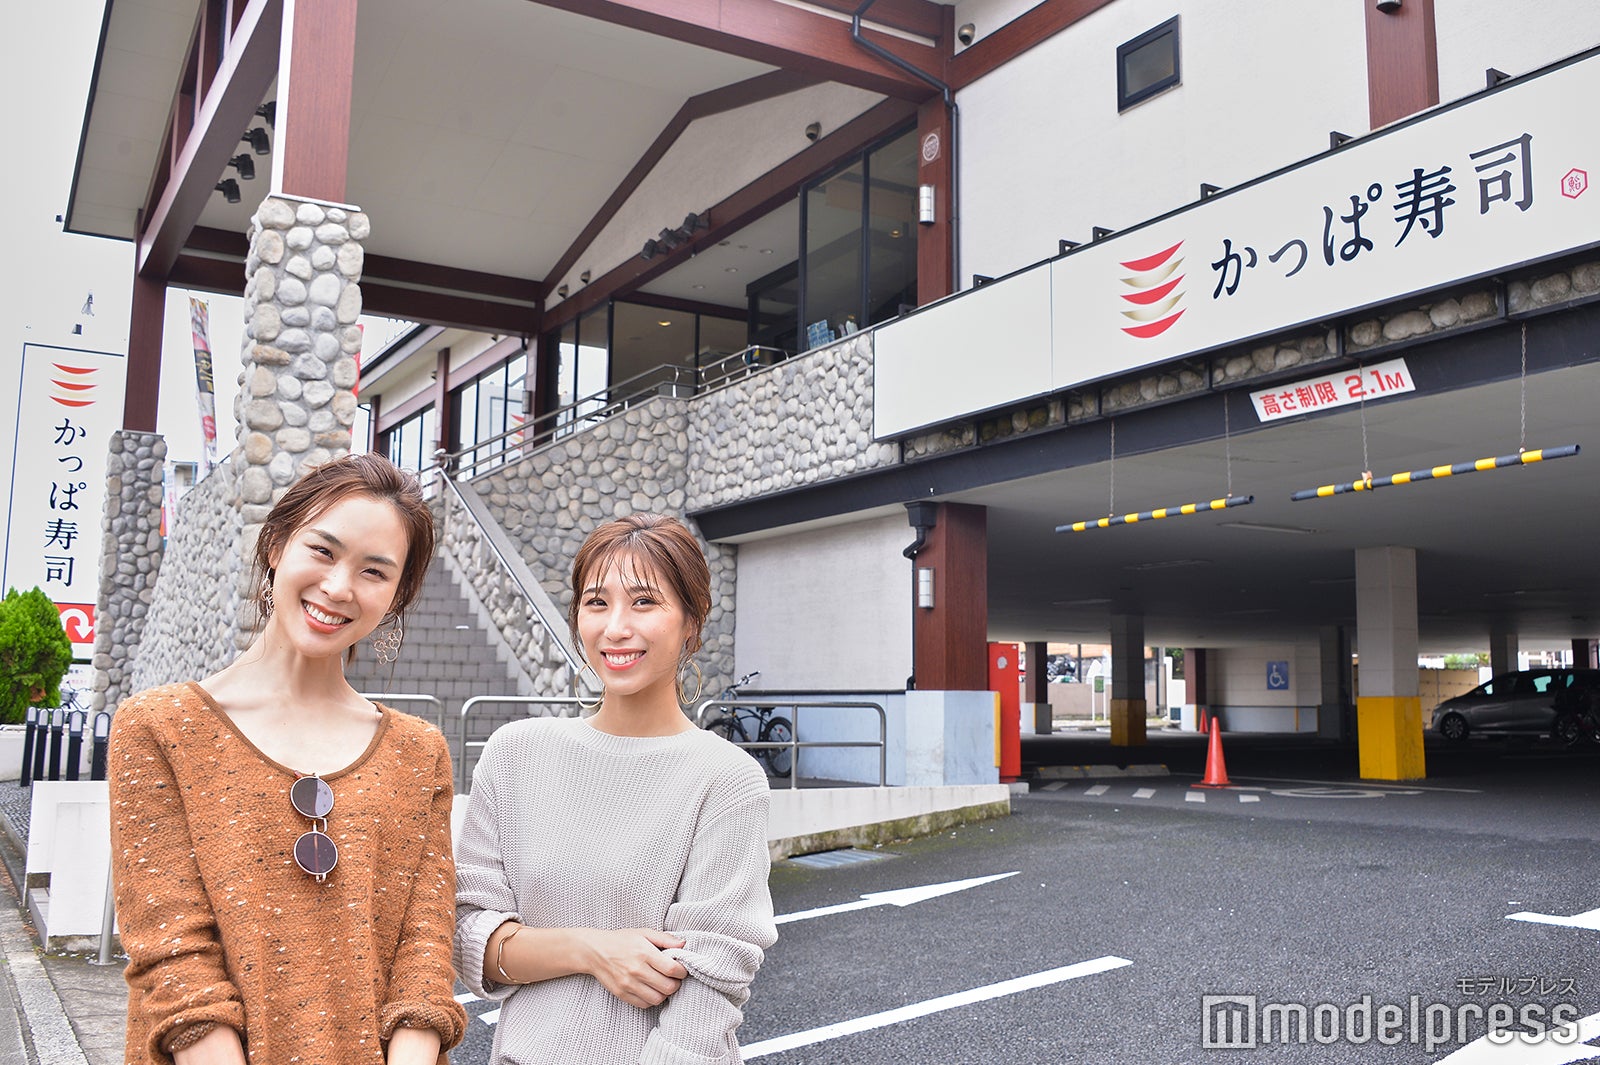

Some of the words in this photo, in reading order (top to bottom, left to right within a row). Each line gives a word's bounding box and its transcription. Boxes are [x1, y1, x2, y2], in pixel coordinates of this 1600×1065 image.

[1211, 132, 1534, 300] かっぱ寿司
[1259, 380, 1338, 416] 高さ制限
[1344, 369, 1405, 398] 2.1M
[44, 418, 87, 587] かっぱ寿司
